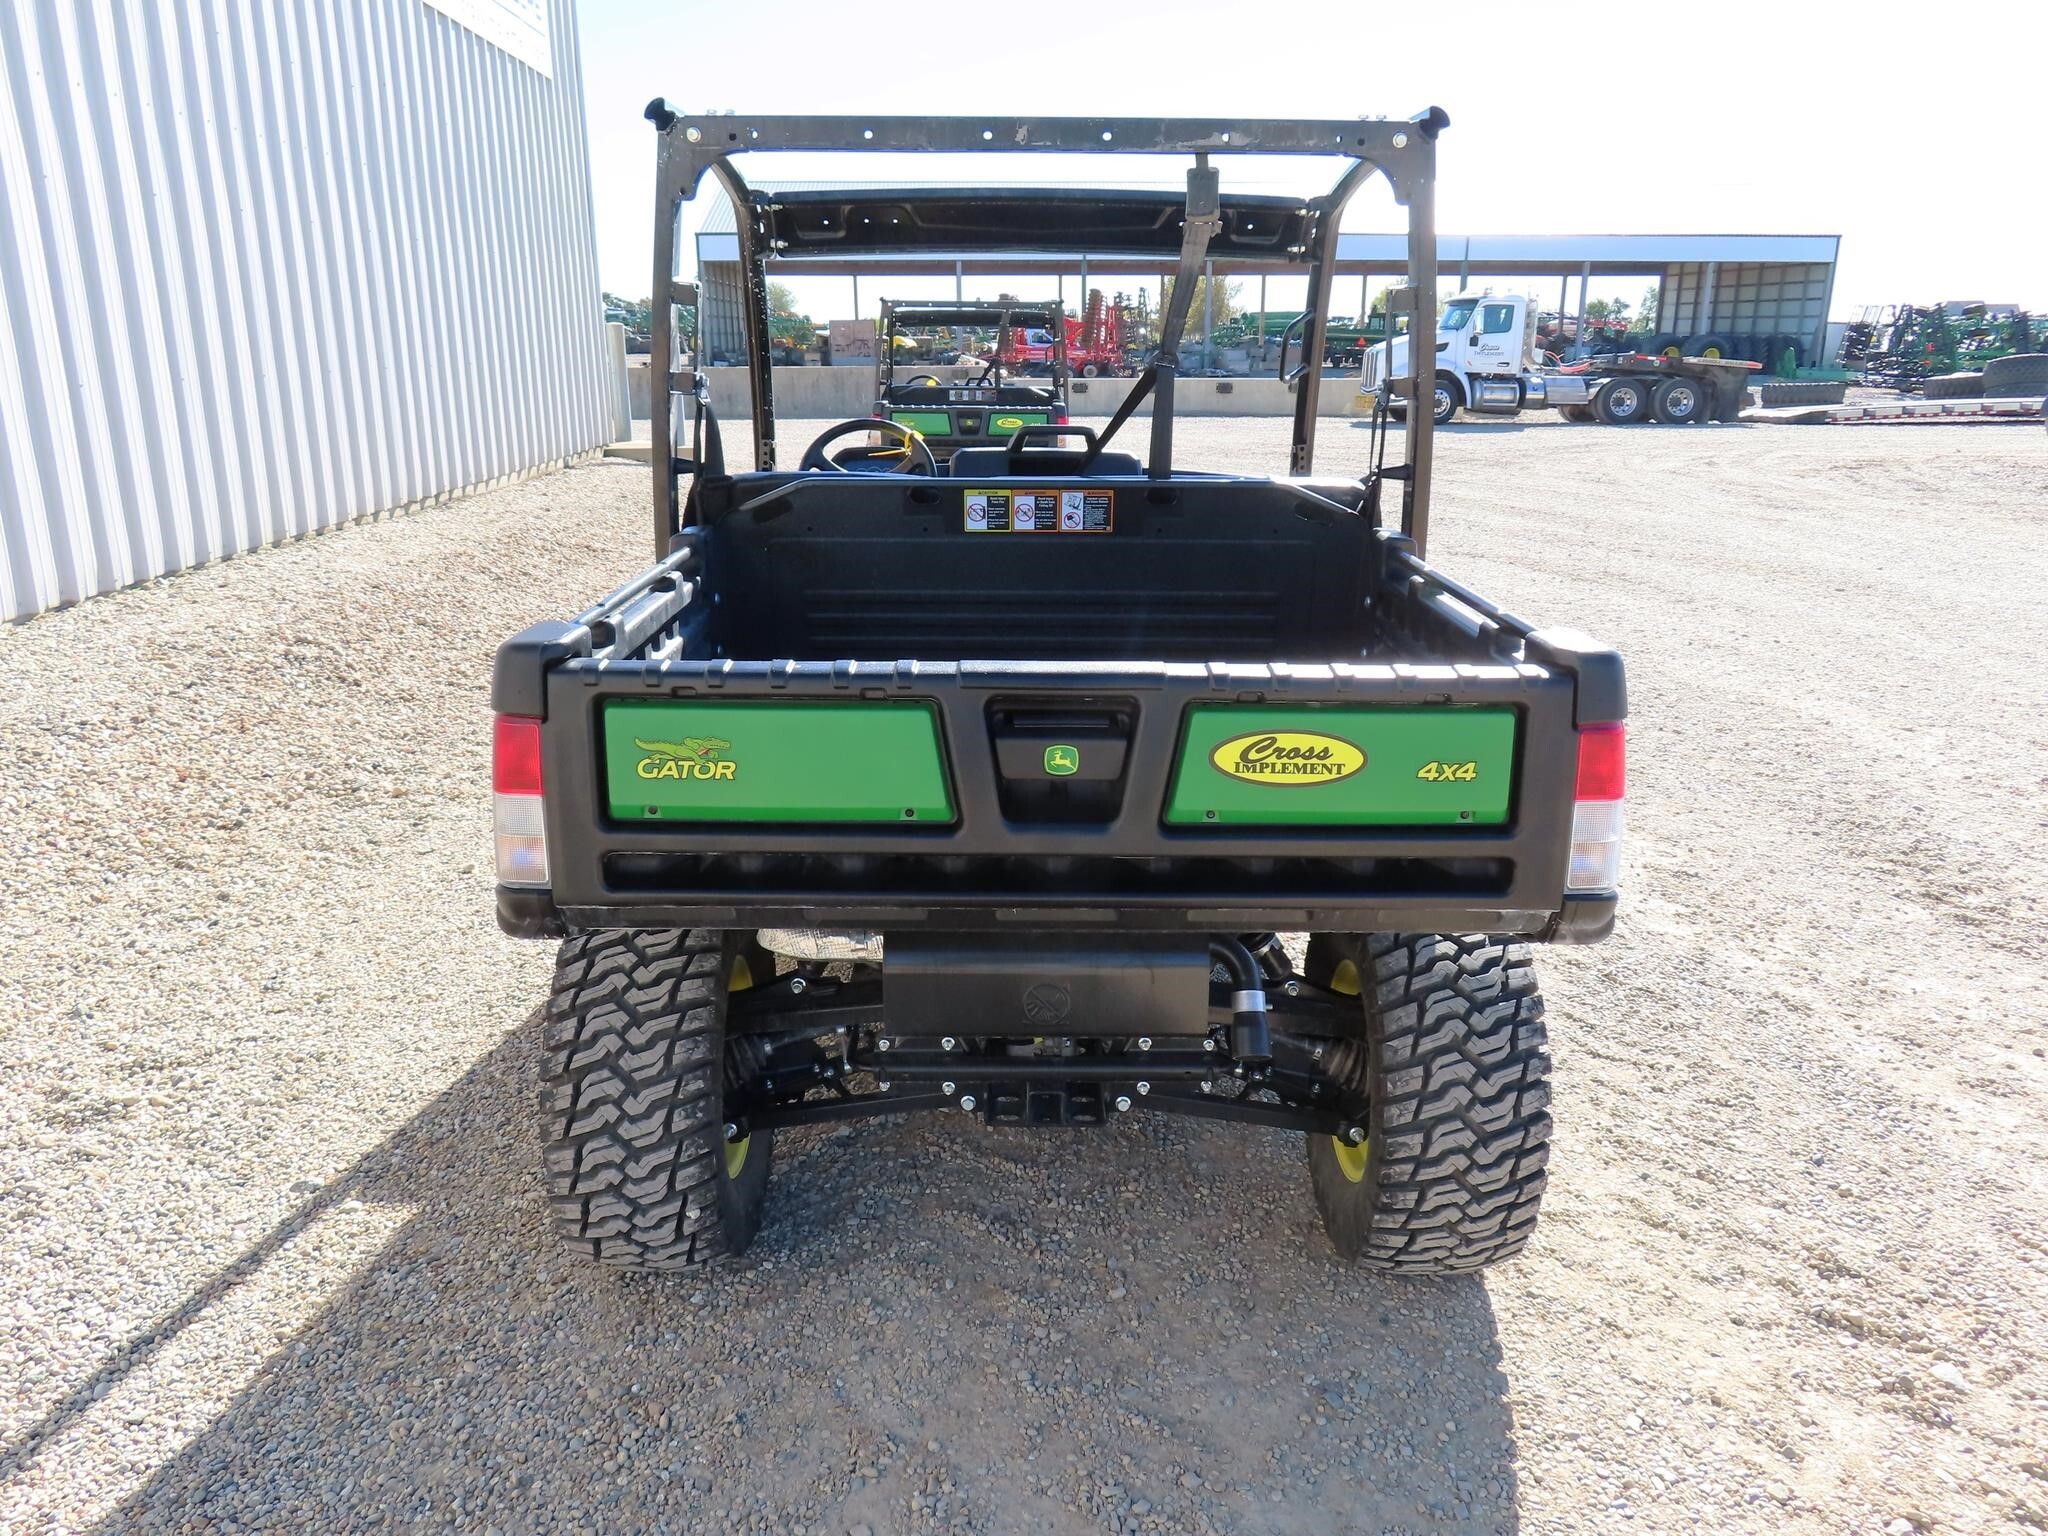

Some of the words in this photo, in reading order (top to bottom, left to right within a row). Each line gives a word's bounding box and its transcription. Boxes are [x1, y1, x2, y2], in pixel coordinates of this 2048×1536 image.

[1239, 735, 1334, 764] Cross
[636, 758, 737, 781] GATOR
[1234, 761, 1346, 776] IMPLEMENT
[1416, 760, 1478, 782] 4x4
